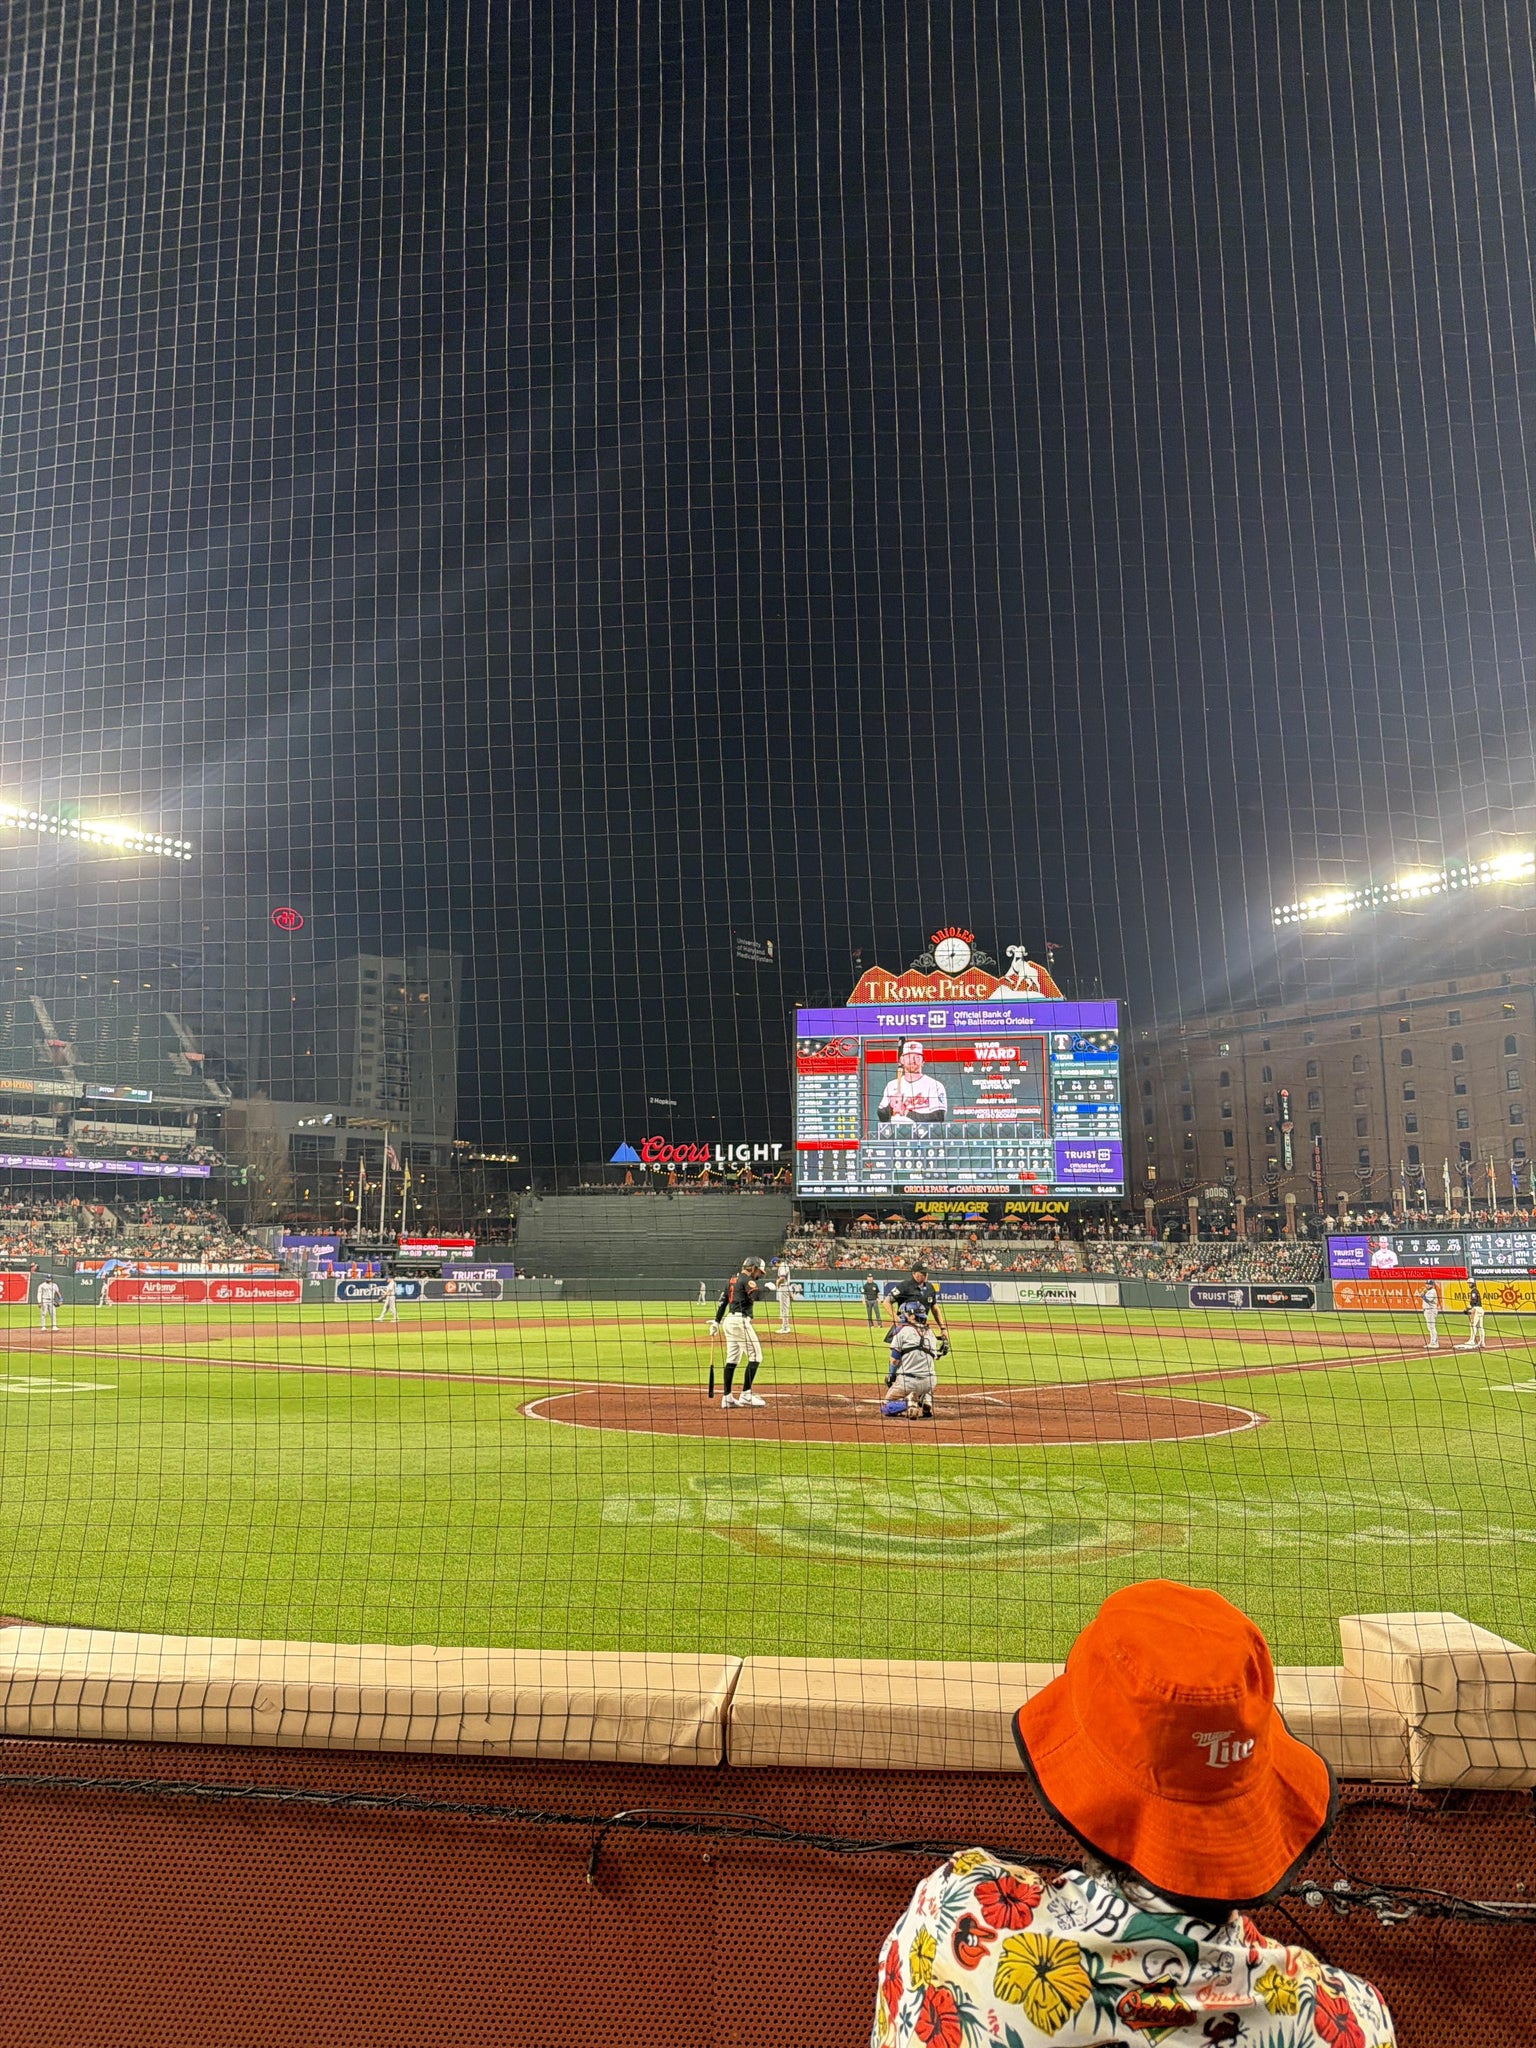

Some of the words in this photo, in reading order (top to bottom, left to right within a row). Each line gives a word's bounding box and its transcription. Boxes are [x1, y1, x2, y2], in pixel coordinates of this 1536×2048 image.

[931, 927, 975, 944] ORIOLES
[864, 981, 882, 1001] T.
[884, 981, 938, 1001] Rowe
[940, 979, 988, 999] Price
[954, 1011, 982, 1019] Official
[983, 1010, 999, 1019] Bank
[1000, 1010, 1011, 1018] of
[877, 1014, 926, 1027] TRUIST
[954, 1018, 967, 1026] the
[968, 1018, 1005, 1026] Baltimore
[1007, 1017, 1034, 1026] Orioles
[975, 1049, 1016, 1060] WARD
[641, 1135, 712, 1163] Coors
[715, 1144, 783, 1161] LIGHT
[894, 1149, 901, 1157] 0
[905, 1149, 912, 1157] 0
[928, 1149, 935, 1157] 0
[938, 1148, 945, 1157] 2
[996, 1148, 1003, 1157] 3
[1006, 1148, 1014, 1157] 7
[1018, 1148, 1025, 1157] 0
[1032, 1148, 1039, 1157] 4
[1064, 1151, 1097, 1159] TRUIST
[639, 1162, 689, 1172] ROOF
[704, 1161, 752, 1171] DECK
[895, 1160, 901, 1169] 0
[905, 1160, 912, 1169] 0
[916, 1160, 923, 1169] 0
[928, 1160, 934, 1169] 1
[997, 1160, 1003, 1168] 1
[1007, 1160, 1014, 1168] 4
[1018, 1160, 1025, 1168] 0
[1032, 1160, 1039, 1168] 2
[1043, 1160, 1050, 1168] 2
[904, 1185, 930, 1194] ORIOLE
[930, 1185, 948, 1193] PARK
[956, 1185, 987, 1193] CAMDEN
[986, 1185, 1010, 1193] YARDS
[914, 1201, 989, 1214] PUREWAGER
[1004, 1201, 1070, 1214] PAVILION
[1434, 1257, 1440, 1265] K
[177, 1262, 209, 1273] BIRD
[212, 1262, 244, 1273] BATH
[80, 1278, 93, 1286] 363
[143, 1282, 176, 1293] Airtemp
[458, 1282, 482, 1292] PNC
[815, 1282, 846, 1293] Rowe
[235, 1287, 295, 1298] Budweiser
[941, 1292, 969, 1300] Health
[1197, 1292, 1227, 1301] TRUIST
[1358, 1288, 1403, 1297] AUTUMN
[1191, 1731, 1236, 1747] Miller
[1205, 1738, 1255, 1769] Lite
